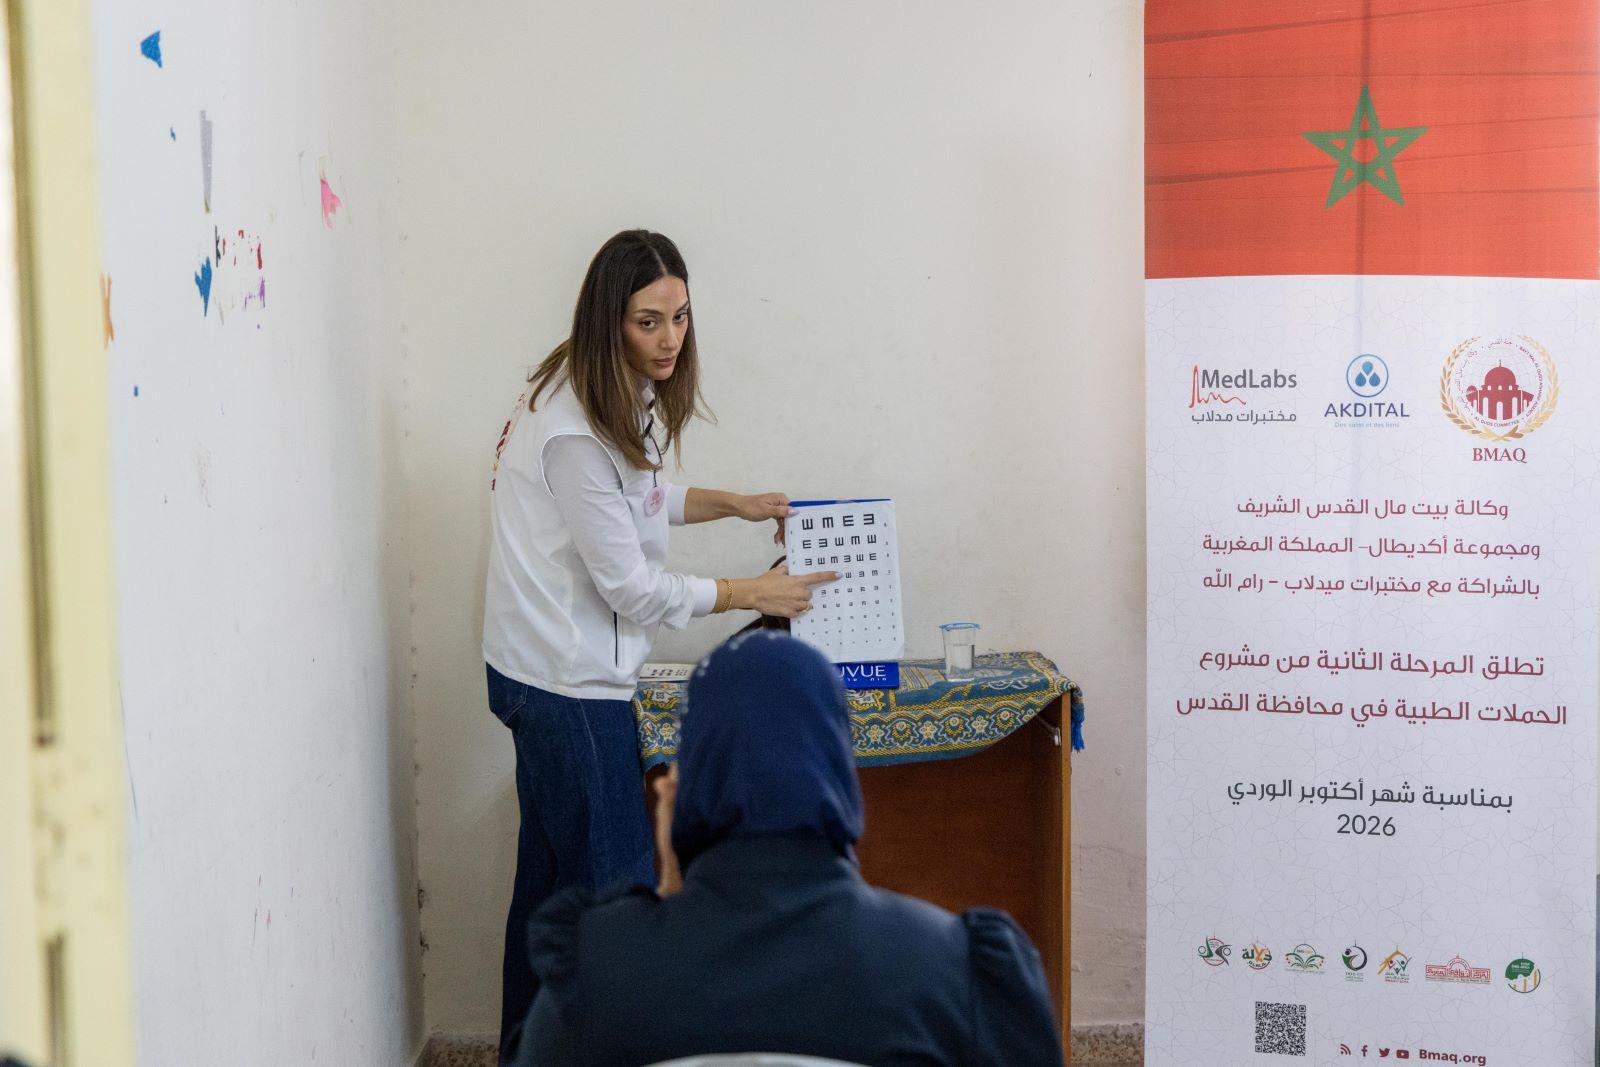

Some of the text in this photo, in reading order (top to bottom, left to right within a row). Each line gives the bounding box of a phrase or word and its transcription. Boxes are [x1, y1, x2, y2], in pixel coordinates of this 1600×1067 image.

[1202, 369, 1297, 388] MedLabs
[1192, 410, 1296, 425] مختبرات مدلاب
[1324, 403, 1410, 417] AKDITAL
[1472, 448, 1527, 464] BMAQ
[1238, 495, 1508, 520] وكالة بيت مال القدس الشريف
[1203, 535, 1272, 554] المغربية
[1279, 536, 1352, 553] المملكة
[1454, 539, 1540, 560] ومجموعة
[1238, 574, 1263, 593] رام
[1285, 575, 1344, 595] ميدلاب
[1351, 576, 1420, 596] مختبرات
[1427, 580, 1451, 596] مع
[1458, 576, 1539, 599] بالشراكة
[1200, 644, 1544, 680] تطلق المرحلة الثانية من مشروع
[1177, 693, 1566, 727] الحملات الطبية في محافظة القدس
[1228, 778, 1512, 813] بمناسبة شهر أكتوبر الوردي
[1337, 814, 1395, 836] 2026
[1419, 1049, 1486, 1066] Bmaq.org
